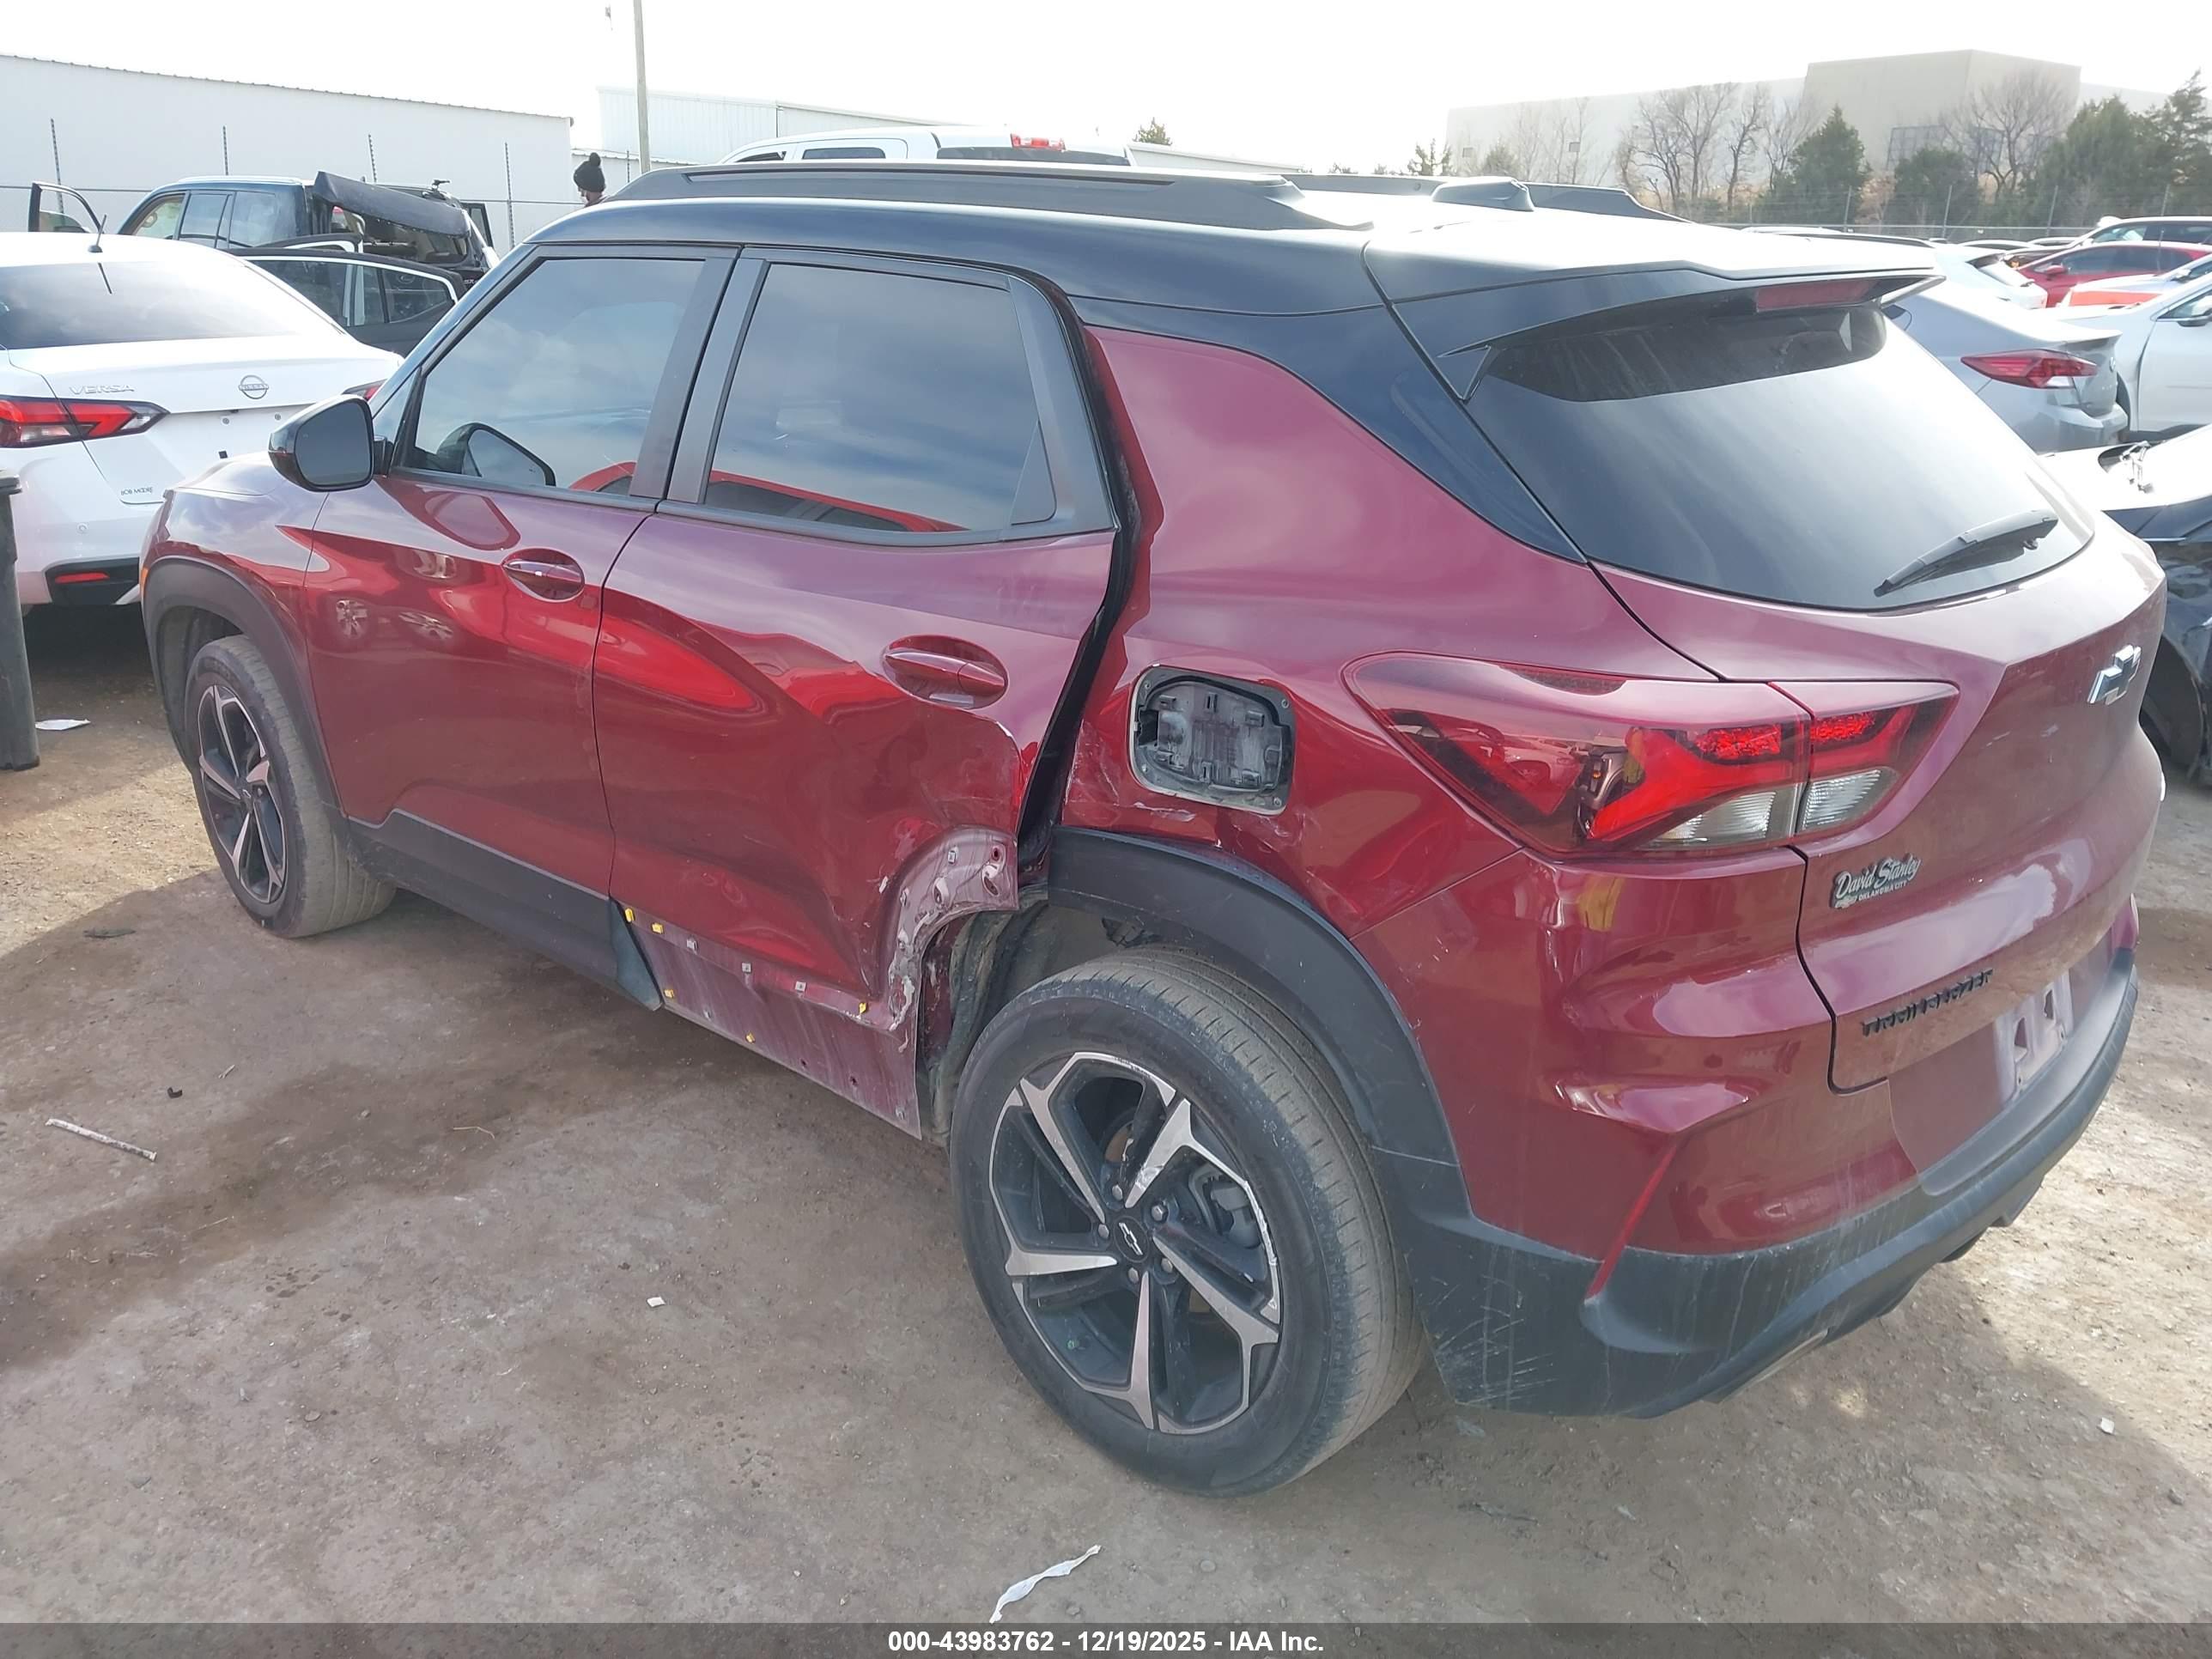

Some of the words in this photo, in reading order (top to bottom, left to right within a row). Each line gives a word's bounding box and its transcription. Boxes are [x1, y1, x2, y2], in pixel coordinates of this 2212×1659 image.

[69, 385, 135, 395] VERSA
[1835, 864, 1878, 899] David
[1873, 853, 1922, 890] Stanley
[1894, 879, 1907, 890] CITY
